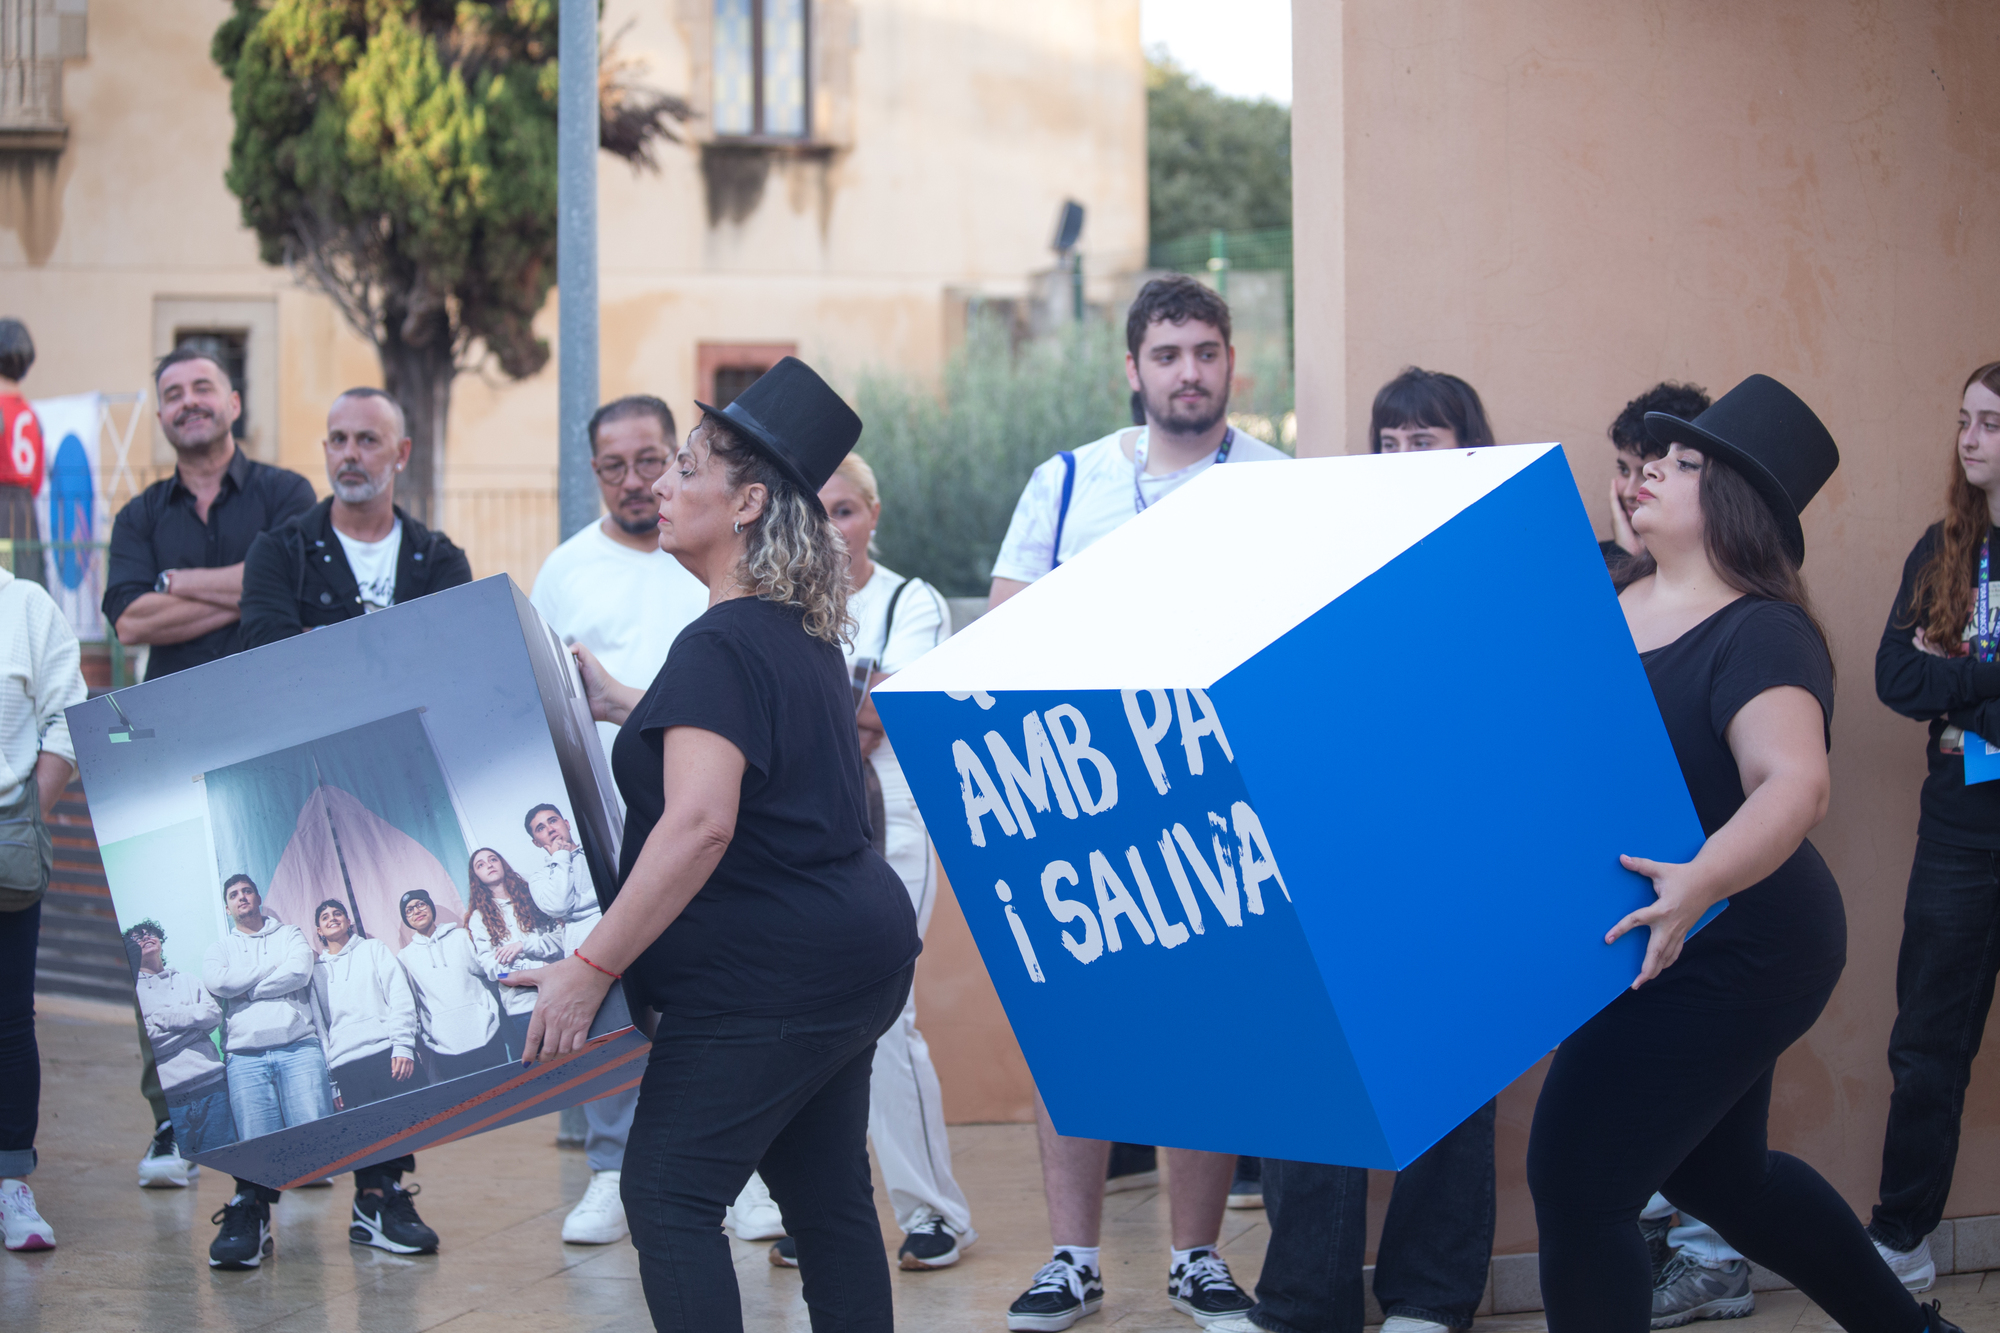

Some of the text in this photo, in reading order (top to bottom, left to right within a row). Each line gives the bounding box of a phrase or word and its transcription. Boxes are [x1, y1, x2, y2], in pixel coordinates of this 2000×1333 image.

[12, 410, 37, 475] 6
[952, 688, 1235, 848] AMB PA
[1040, 800, 1293, 966] SALIVA
